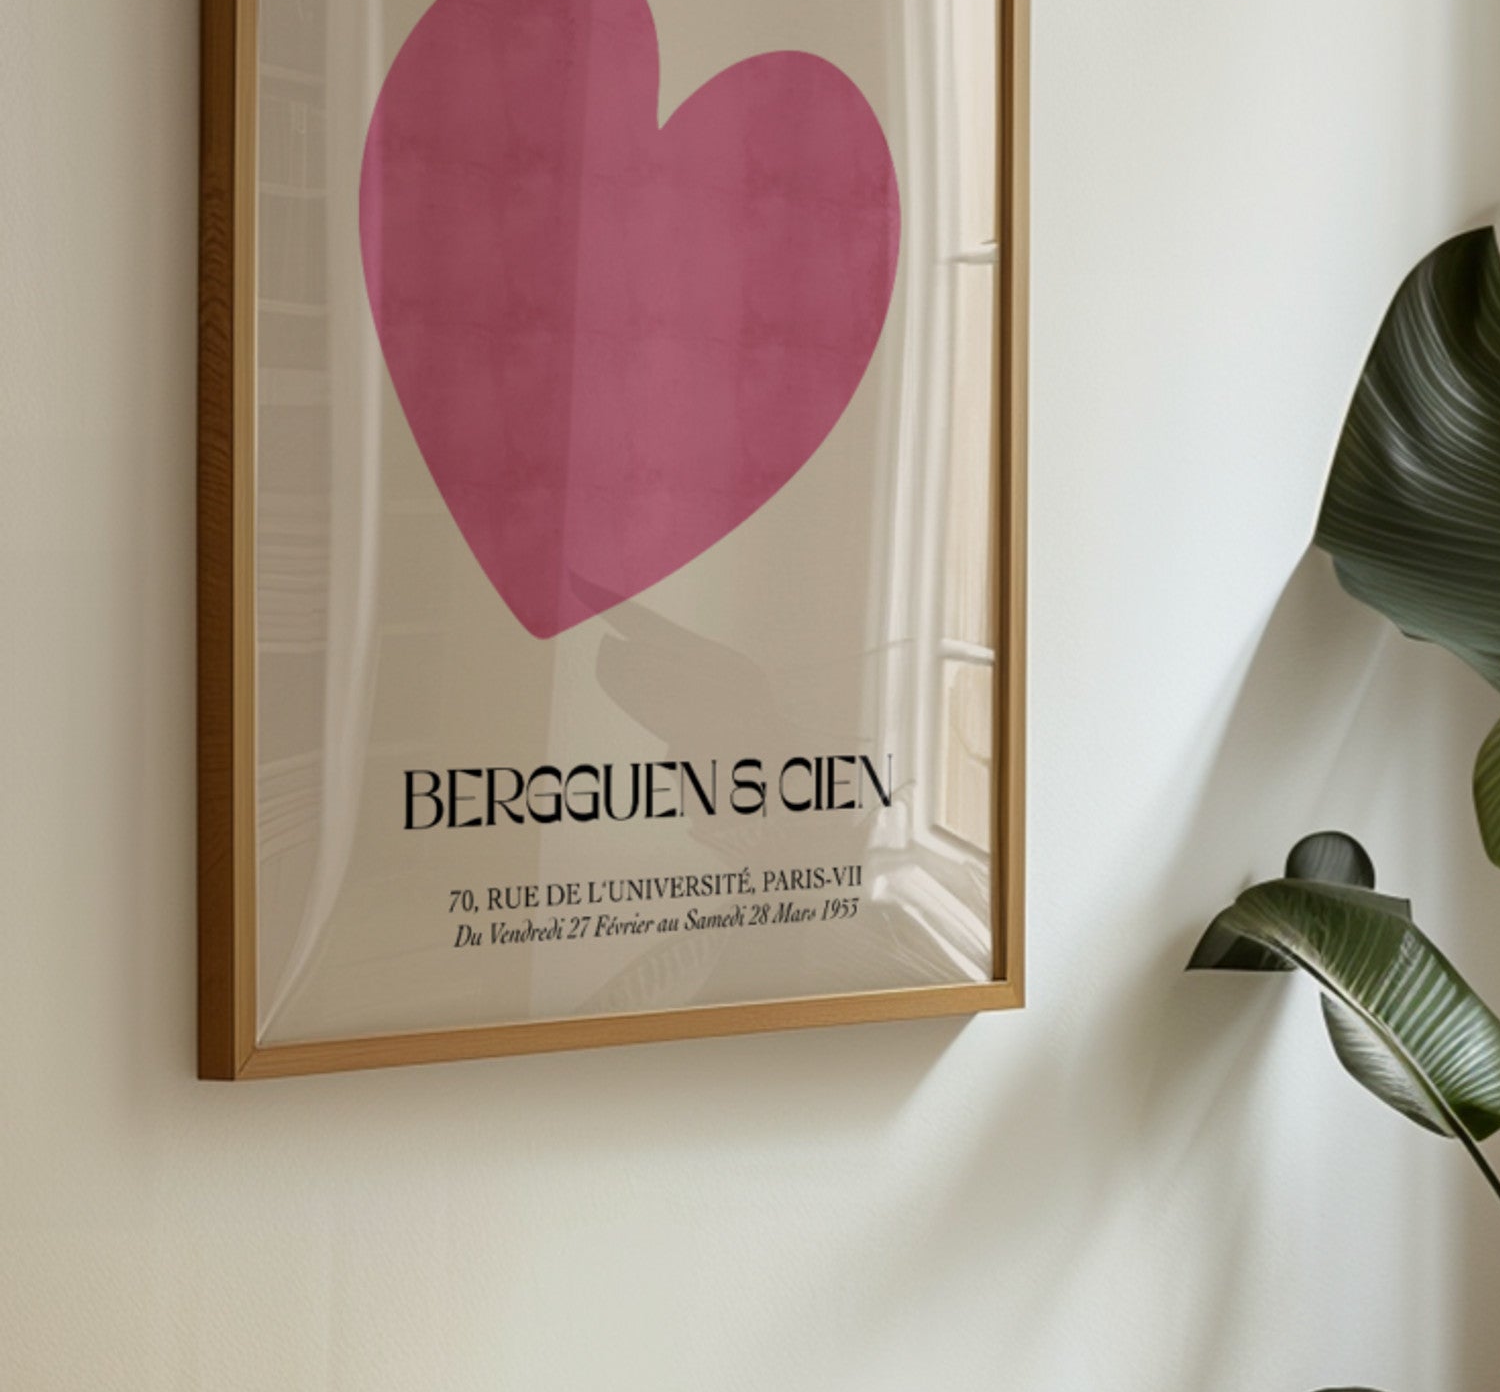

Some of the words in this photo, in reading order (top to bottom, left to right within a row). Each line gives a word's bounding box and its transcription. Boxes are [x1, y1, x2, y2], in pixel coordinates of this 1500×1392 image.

[403, 759, 717, 830] BERGGUEN
[729, 758, 767, 817] &
[779, 753, 893, 811] CIEN
[448, 889, 479, 914] 70,
[487, 885, 540, 911] RUE
[547, 882, 582, 907] DE
[762, 865, 863, 892] PARIS-VII
[454, 924, 482, 948] Du
[491, 917, 565, 944] Vendredi
[566, 916, 591, 939] 27
[594, 912, 655, 938] Février
[656, 918, 680, 933] au
[683, 904, 746, 931] Samedi
[748, 903, 771, 926] 28
[772, 901, 817, 924] Mars
